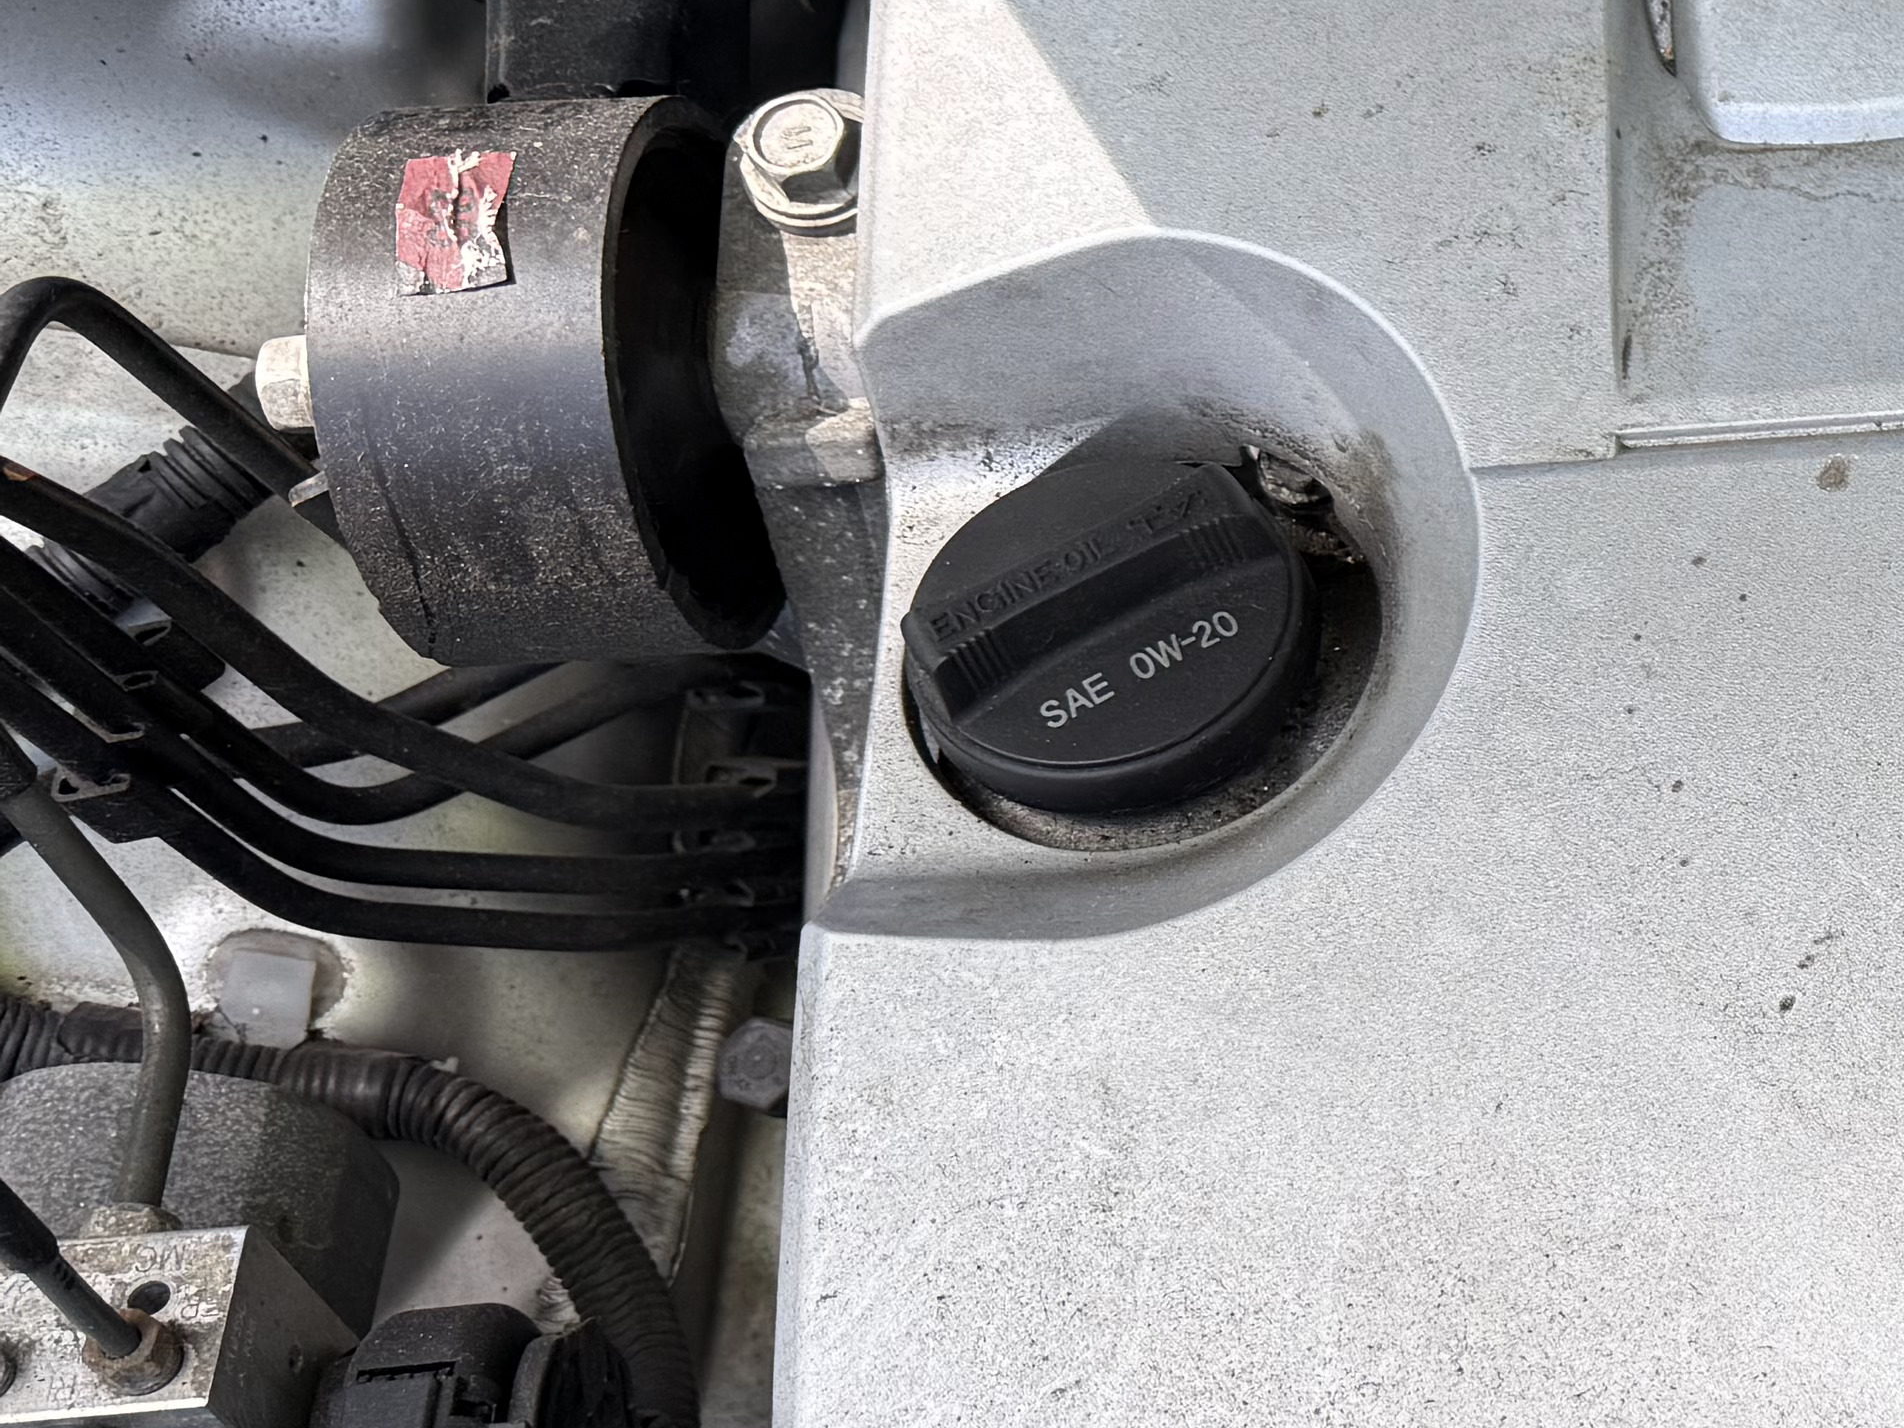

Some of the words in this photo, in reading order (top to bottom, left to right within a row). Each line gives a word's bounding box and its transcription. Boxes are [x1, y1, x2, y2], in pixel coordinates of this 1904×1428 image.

[930, 557, 1055, 643] ENGINE
[1039, 672, 1116, 730] SAE
[1129, 609, 1241, 681] 0W-20
